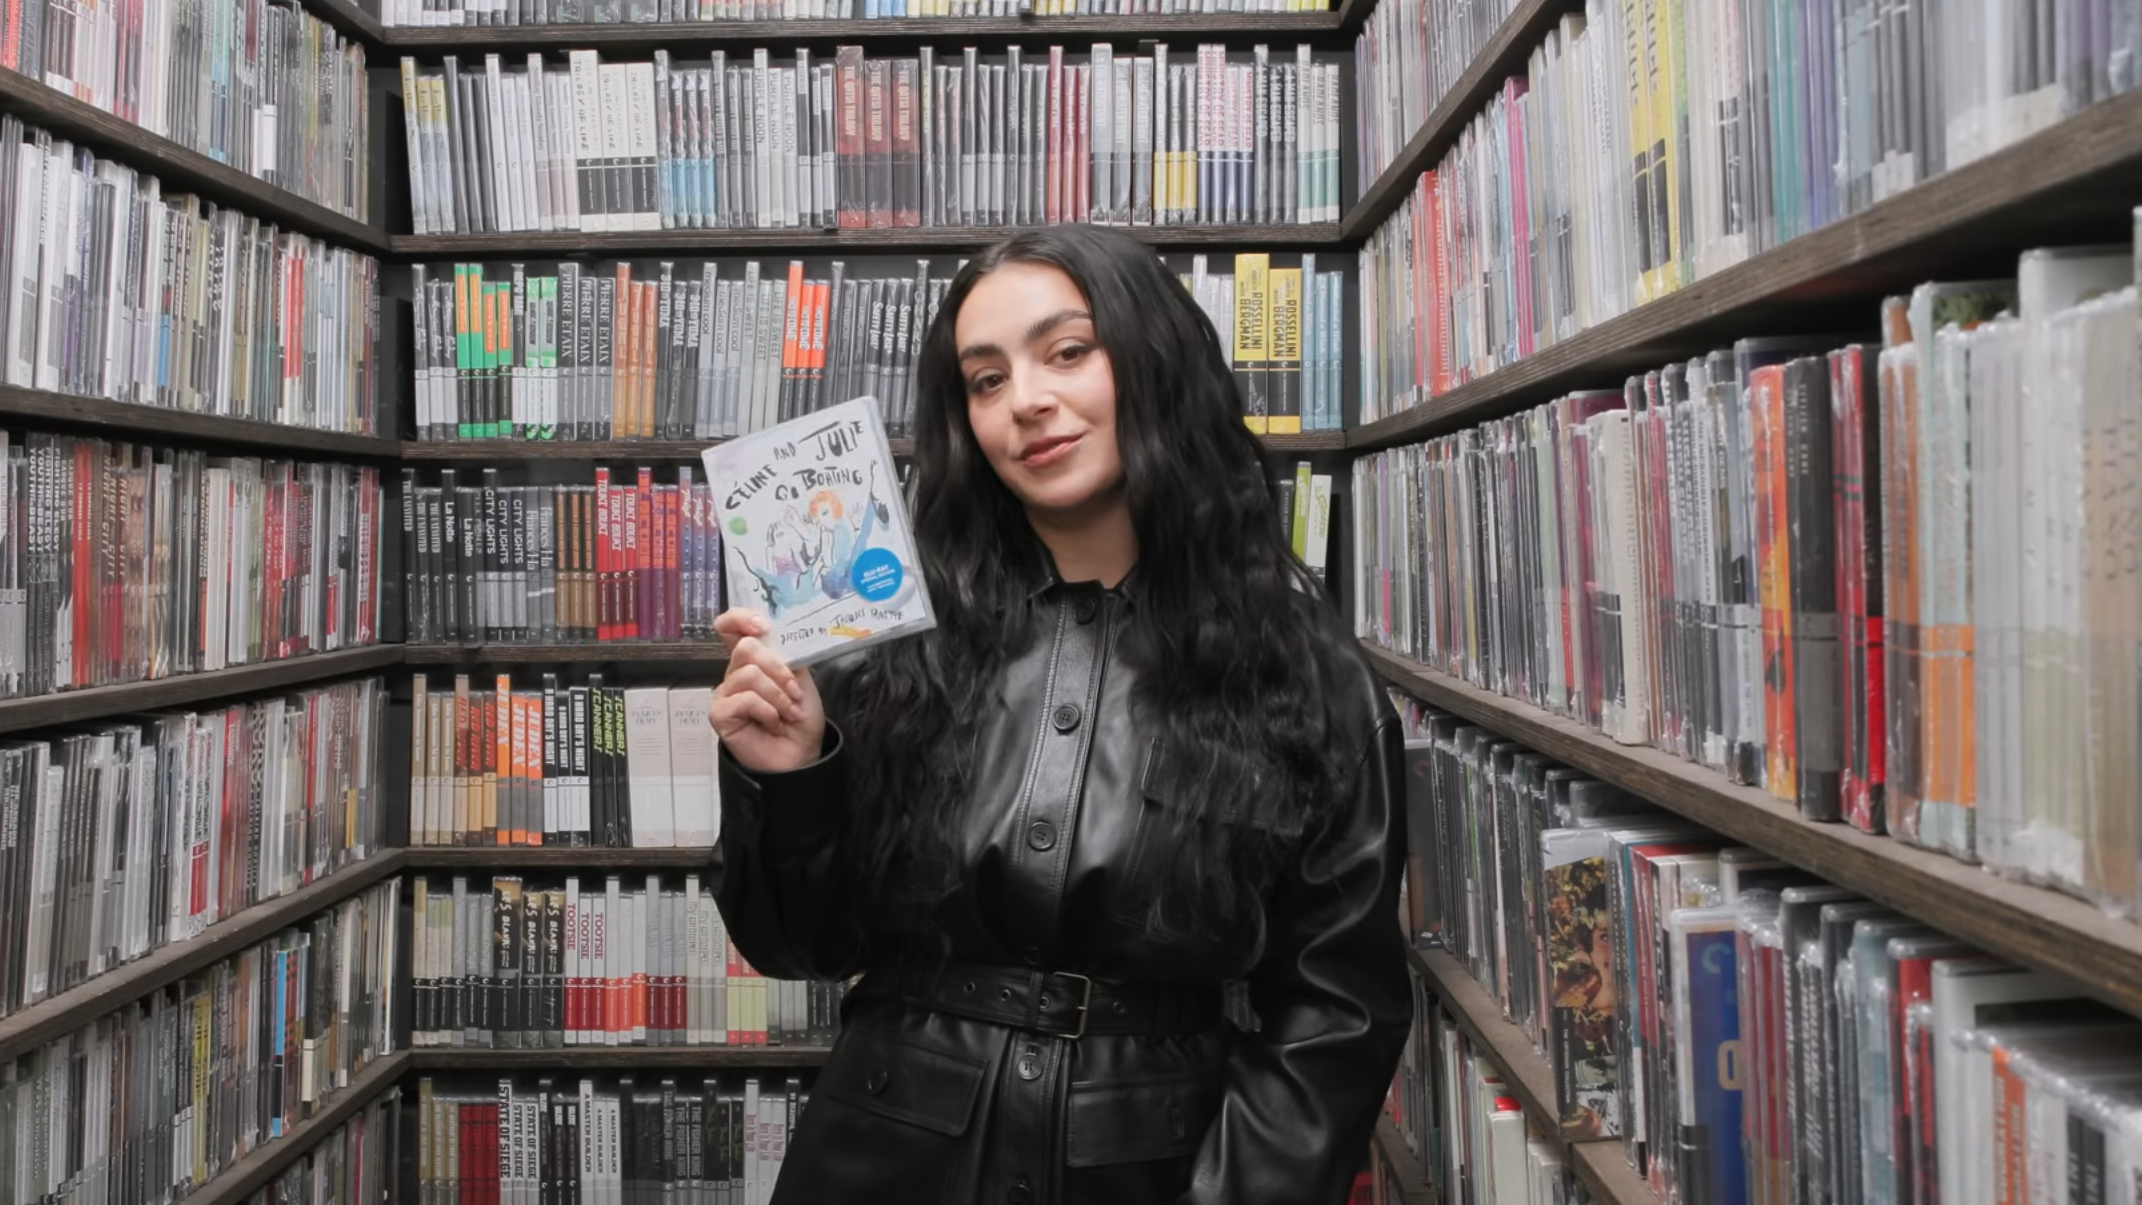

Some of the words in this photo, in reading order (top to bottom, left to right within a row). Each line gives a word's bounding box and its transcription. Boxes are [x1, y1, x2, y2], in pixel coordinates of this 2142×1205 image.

[573, 60, 585, 106] TRILOGY
[755, 67, 764, 111] PURPLE
[769, 73, 778, 115] PURPLE
[784, 77, 794, 118] PURPLE
[579, 109, 586, 123] OF
[756, 115, 766, 143] NOON
[580, 126, 589, 151] LIFE
[771, 119, 780, 149] NOON
[785, 121, 794, 152] NOON
[514, 272, 524, 293] REPO
[562, 273, 573, 316] PIERRE
[748, 271, 756, 289] LIFE
[581, 280, 592, 322] PIERRE
[600, 280, 610, 323] PIERRE
[660, 299, 670, 327] YUMA
[717, 291, 726, 331] medium
[733, 289, 741, 329] medium
[760, 294, 769, 313] LIFE
[773, 292, 782, 311] LIFE
[673, 318, 684, 346] YUMA
[688, 320, 698, 348] YUMA
[702, 314, 710, 334] cool
[745, 307, 754, 339] SWEET
[1239, 299, 1251, 350] BERGMAN
[1251, 292, 1263, 350] ROSSELLINI
[1273, 306, 1285, 357] BERGMAN
[1284, 299, 1297, 357] ROSSELLINI
[716, 333, 724, 354] cool
[731, 331, 739, 351] cool
[757, 329, 767, 360] SWEET
[771, 327, 781, 360] SWEET
[1799, 383, 1807, 433] CITIZEN
[774, 442, 797, 460] AND
[798, 420, 864, 461] JULIE
[1718, 451, 1726, 489] GEMS
[1801, 443, 1809, 475] KANE
[103, 455, 111, 499] NIGHT
[598, 479, 607, 506] TOUKI
[775, 484, 799, 501] GO
[793, 466, 863, 491] BOATING
[109, 478, 117, 521] NIGHT
[120, 478, 128, 521] NIGHT
[445, 502, 454, 514] La
[485, 490, 495, 515] CITY
[498, 500, 507, 525] CITY
[513, 499, 523, 525] CITY
[611, 494, 621, 522] TOUKI
[625, 492, 634, 520] TOUKI
[28, 506, 36, 553] BEAST
[36, 508, 44, 552] BEAST
[44, 510, 52, 551] ELEGY
[446, 516, 455, 542] Notte
[464, 518, 473, 530] La
[526, 510, 538, 552] Frances
[541, 506, 552, 548] Frances
[598, 507, 608, 536] BOUKI
[626, 521, 635, 549] BOUKI
[1685, 480, 1695, 560] SIERRA
[101, 522, 110, 556] CITY
[465, 531, 473, 557] Notte
[486, 518, 495, 554] LIGHTS
[499, 528, 508, 564] LIGHTS
[514, 528, 523, 564] LIGHTS
[612, 523, 621, 551] BOUKI
[527, 553, 538, 570] Ha
[541, 550, 553, 567] Ha
[497, 684, 508, 744] JUDEX
[545, 696, 554, 716] HARD
[559, 711, 567, 728] HARD
[574, 701, 584, 722] HARD
[593, 687, 602, 753] SCANNERS
[513, 703, 525, 766] JUDEX
[528, 706, 540, 770] JUDEX
[604, 696, 613, 757] SCANNERS
[615, 696, 625, 757] SCANNERS
[545, 742, 554, 765] NIGHT
[560, 749, 568, 768] NIGHT
[575, 748, 585, 771] NIGHT
[500, 891, 512, 911] LES
[526, 896, 537, 916] LES
[548, 896, 560, 916] LES
[567, 903, 576, 950] TOOTSIE
[581, 912, 589, 959] TOOTSIE
[595, 913, 603, 959] TOOTSIE
[499, 1086, 509, 1125] STATE
[663, 1090, 672, 1107] THE
[514, 1105, 522, 1136] STATE
[527, 1106, 536, 1137] STATE
[676, 1107, 686, 1123] THE
[692, 1107, 701, 1123] THE
[500, 1127, 510, 1142] OF
[514, 1137, 522, 1149] OF
[527, 1138, 536, 1150] OF
[500, 1143, 511, 1178] SIEGE
[514, 1150, 523, 1178] SIEGE
[528, 1151, 536, 1179] SIEGE
